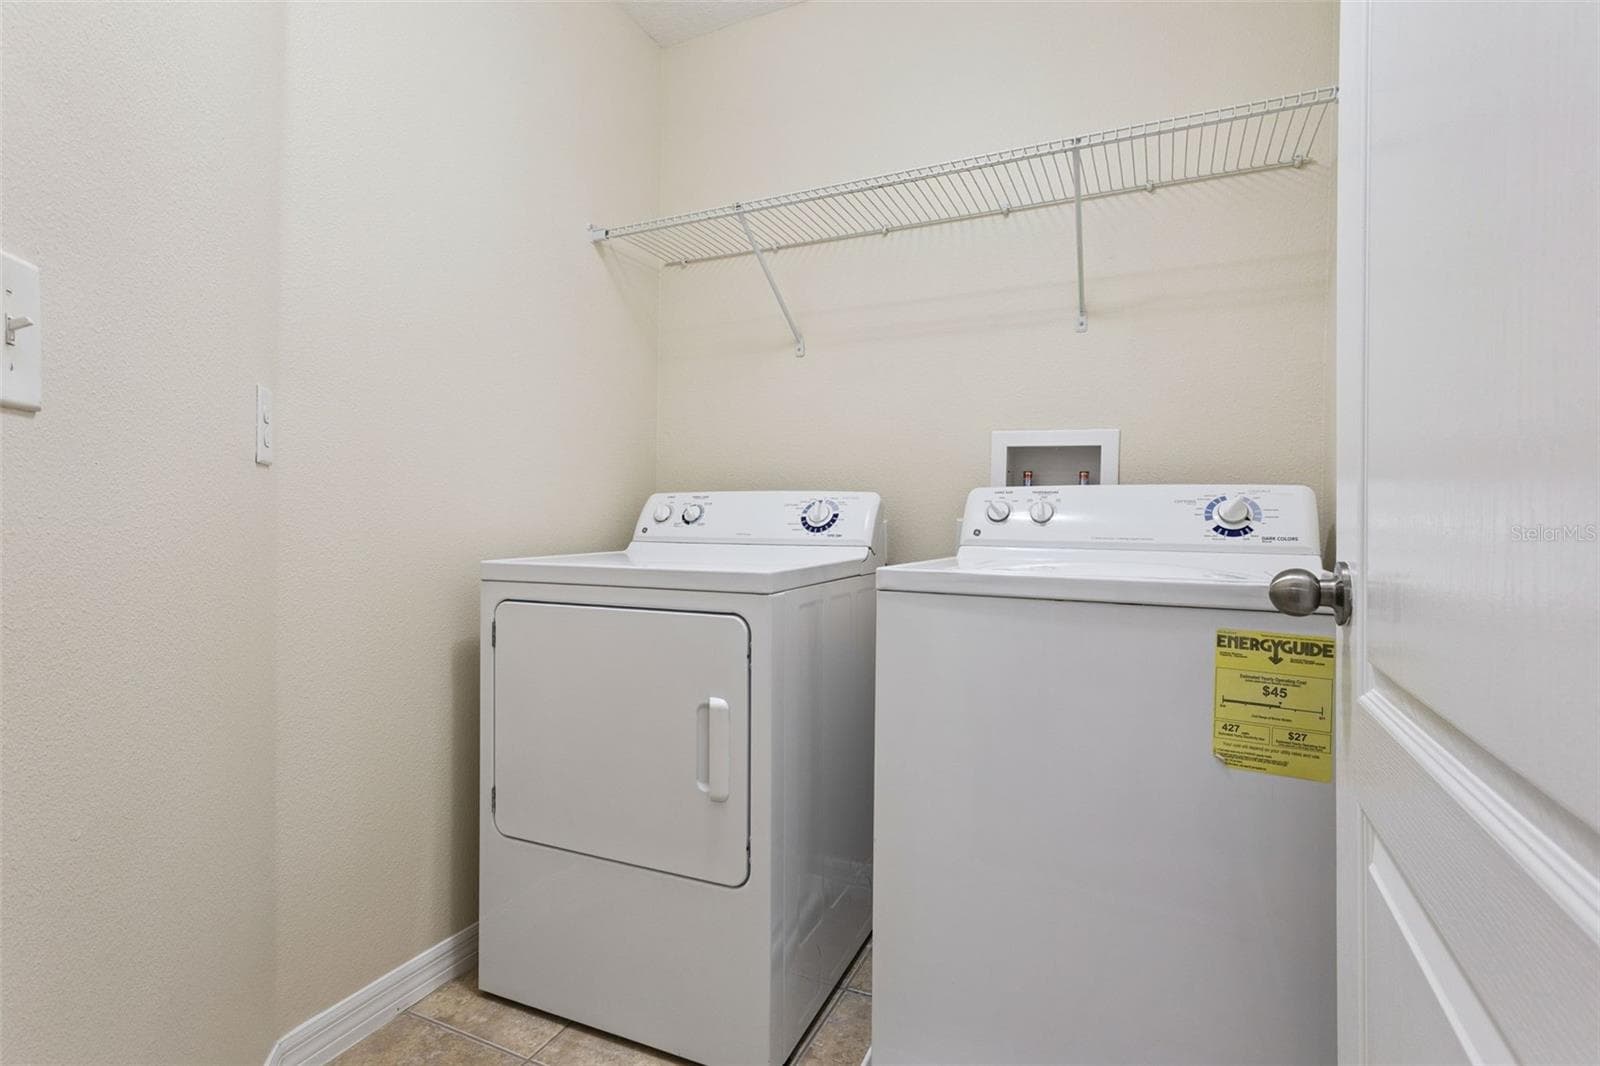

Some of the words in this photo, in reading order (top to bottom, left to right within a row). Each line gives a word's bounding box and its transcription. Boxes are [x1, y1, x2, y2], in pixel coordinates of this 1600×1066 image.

[1216, 634, 1335, 658] ENERGYGUIDE
[1262, 685, 1288, 698] $45
[1222, 723, 1240, 733] 427
[1288, 732, 1308, 742] $27
